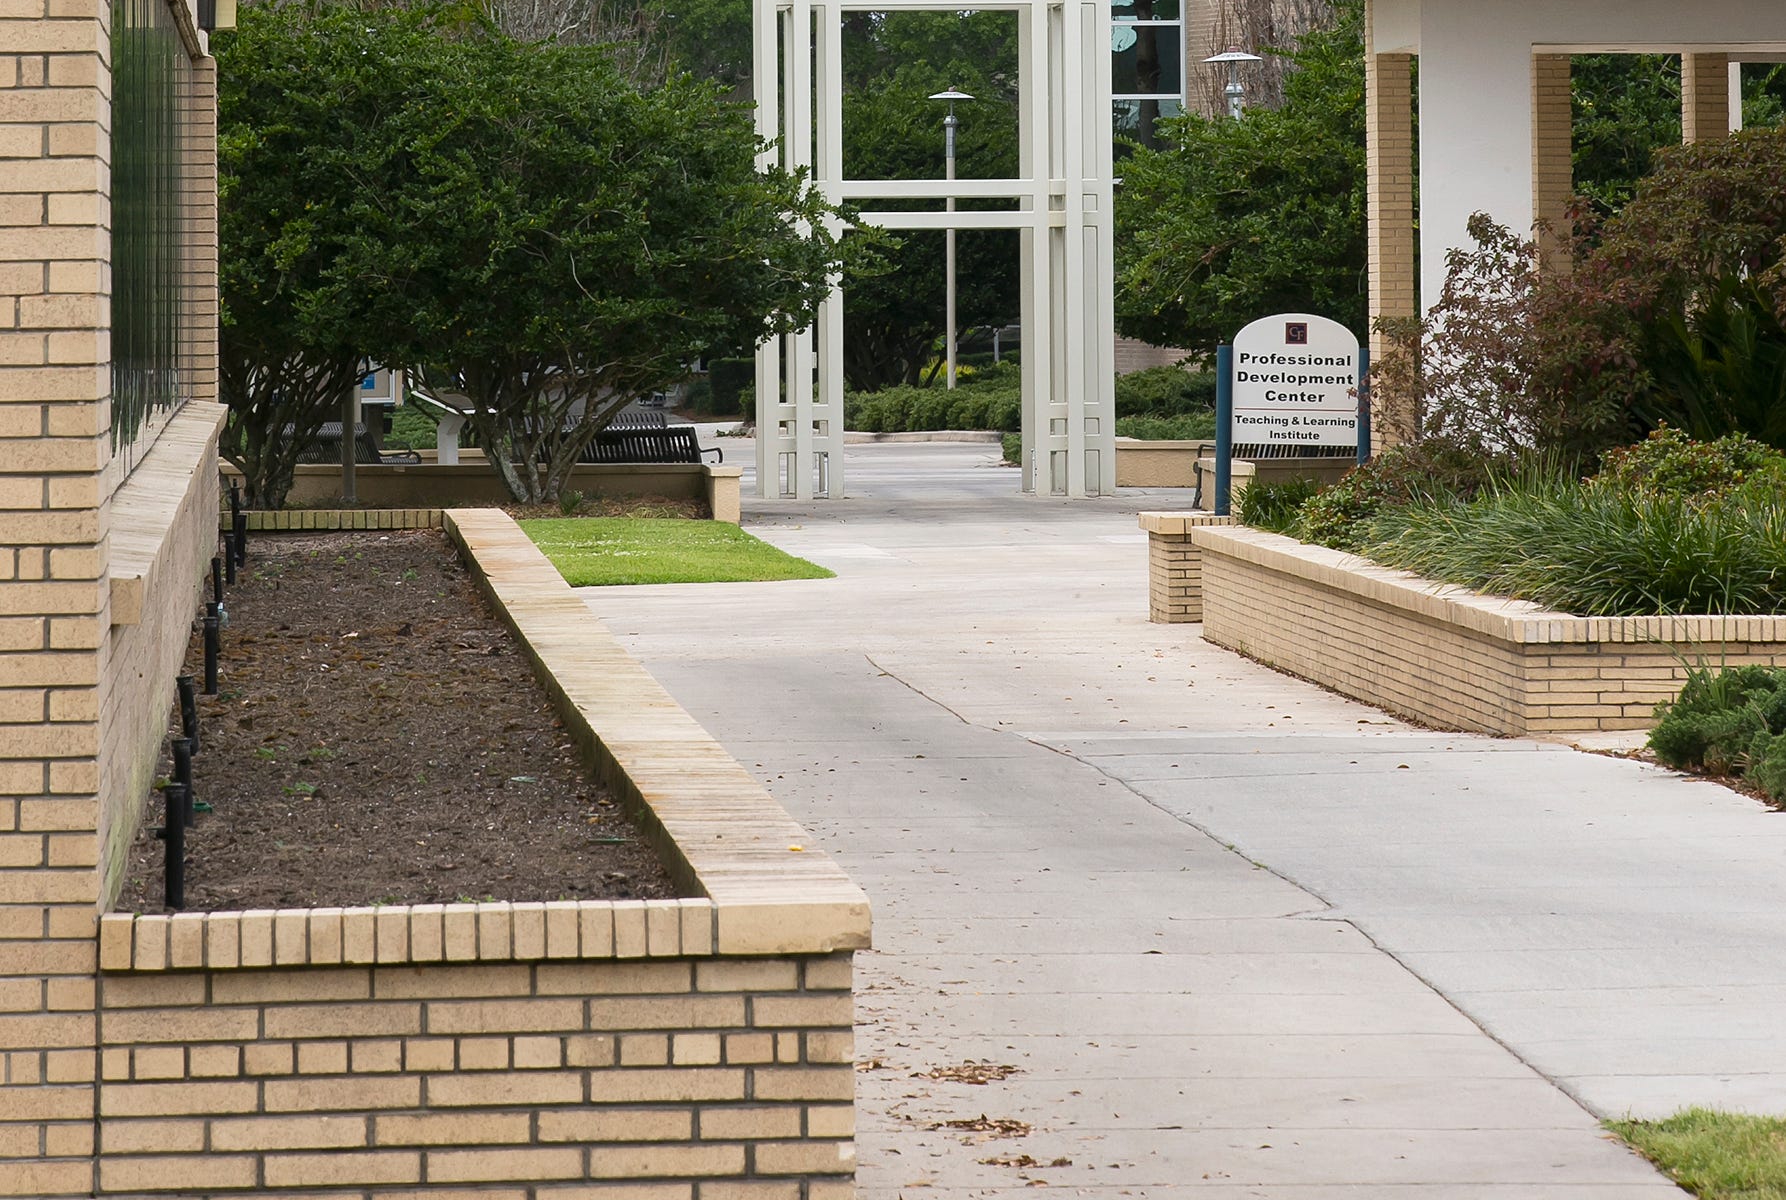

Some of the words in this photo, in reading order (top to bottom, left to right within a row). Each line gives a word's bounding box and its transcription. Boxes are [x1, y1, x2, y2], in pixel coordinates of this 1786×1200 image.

[1239, 353, 1351, 366] Professional
[1237, 371, 1354, 386] Development
[1265, 390, 1326, 403] Center
[1235, 415, 1289, 427] Teaching
[1291, 416, 1300, 426] &
[1303, 417, 1356, 429] Learning
[1269, 430, 1320, 440] Institute
